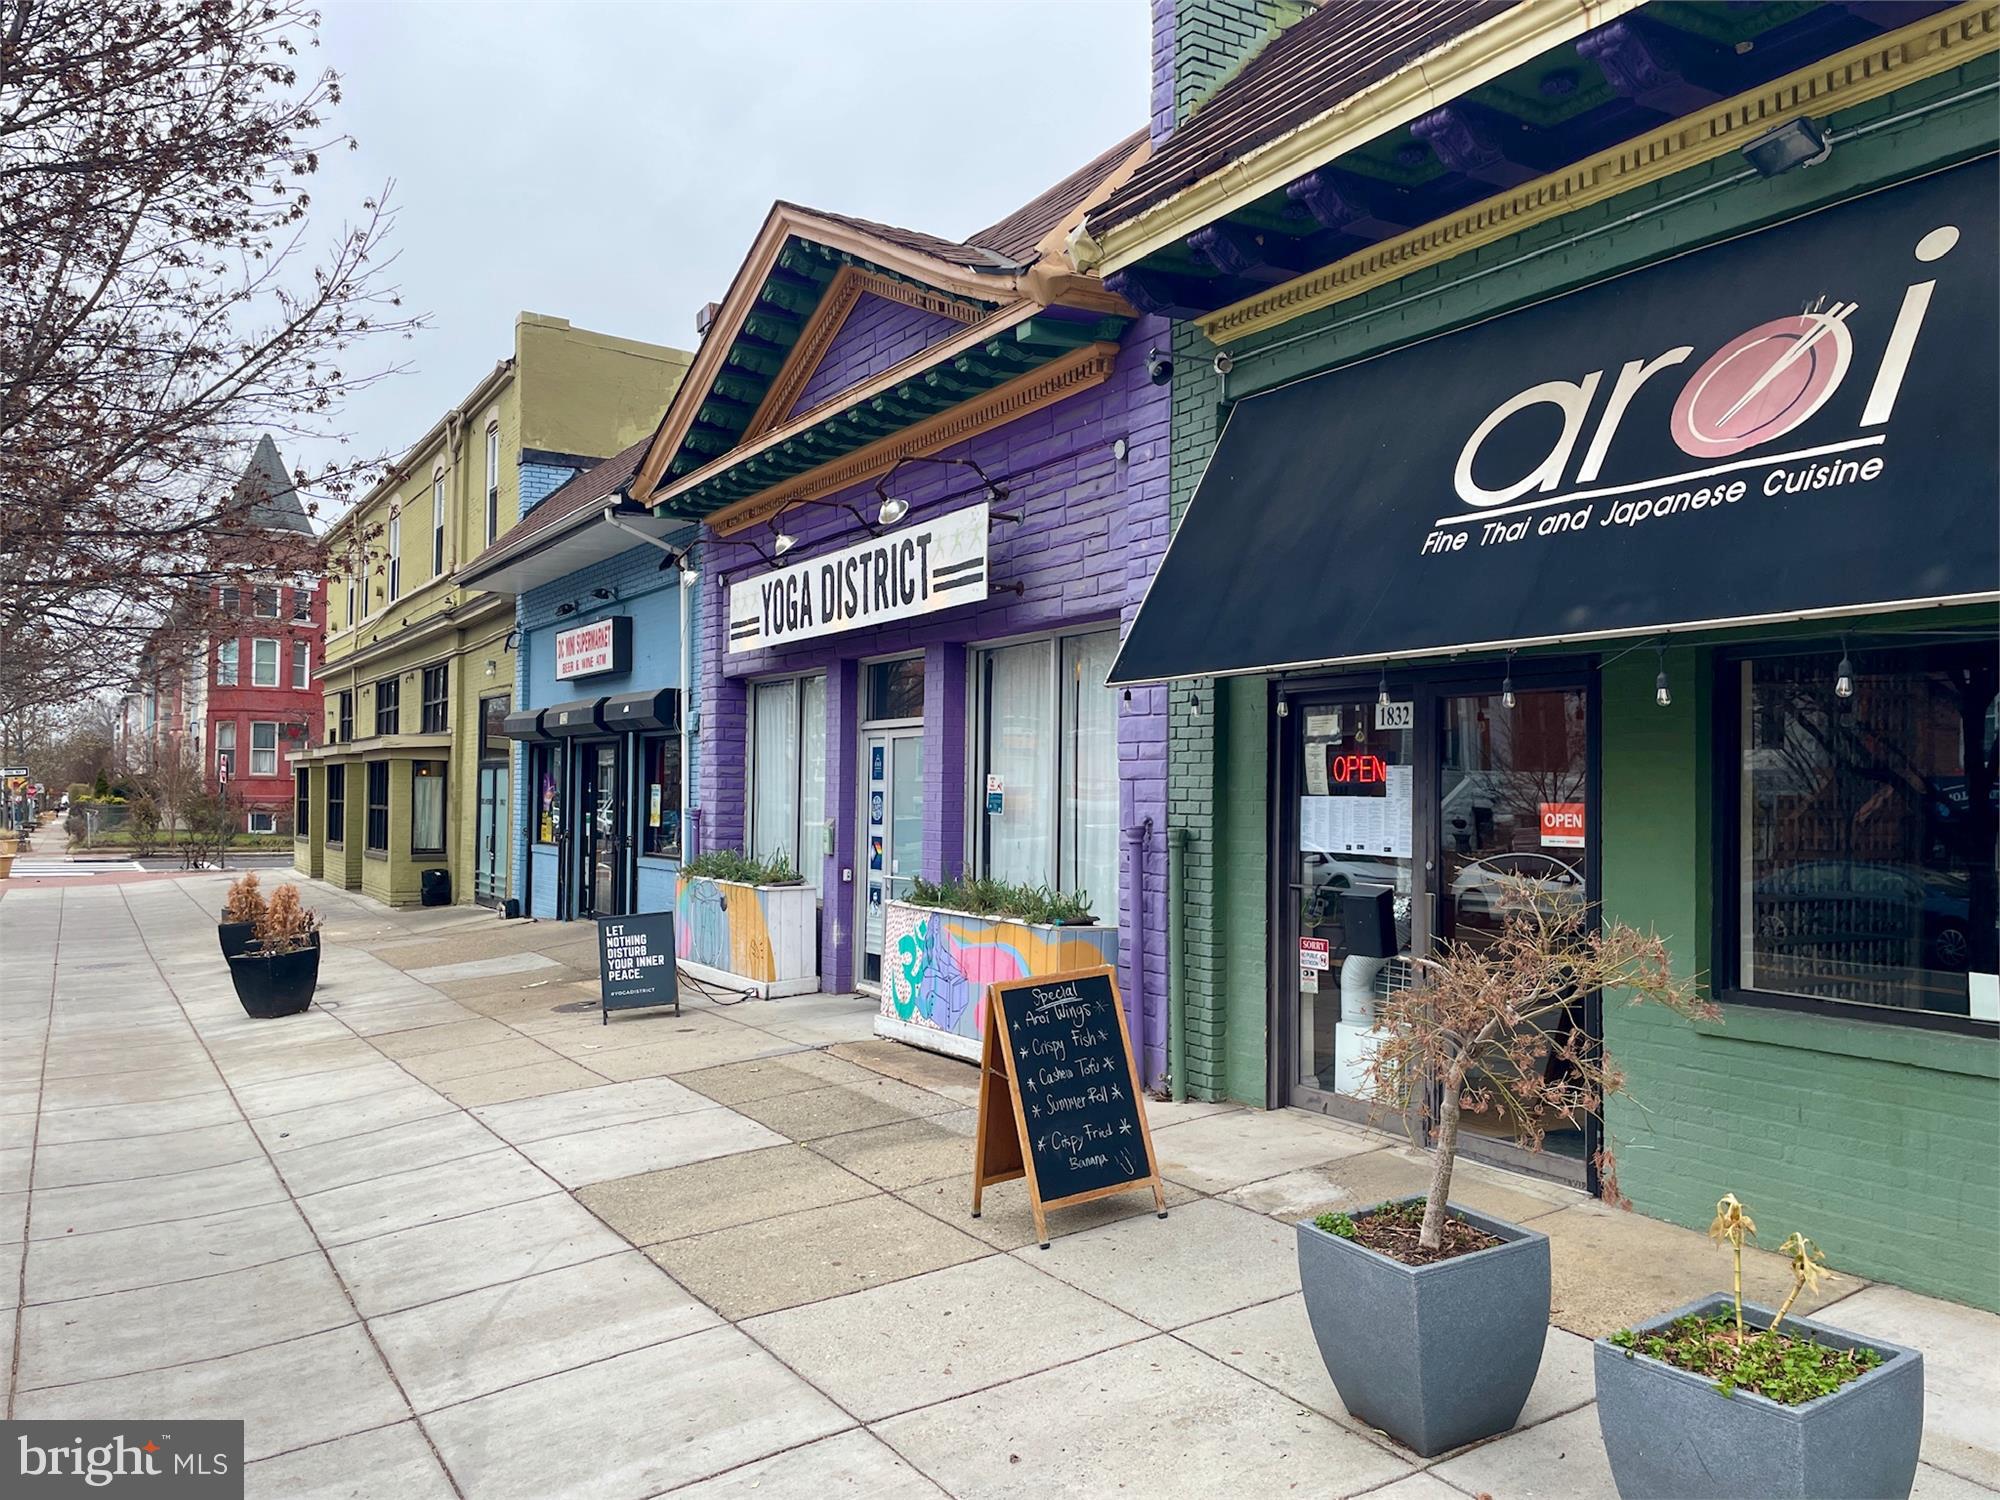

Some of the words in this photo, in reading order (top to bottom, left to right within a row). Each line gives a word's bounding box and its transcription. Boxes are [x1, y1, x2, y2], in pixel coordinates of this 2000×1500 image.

[1453, 225, 1960, 507] aroi
[1421, 530, 1468, 556] Fine
[1480, 516, 1530, 546] Thai
[1537, 504, 1587, 536] and
[1600, 479, 1747, 528] Japanese
[1762, 455, 1885, 495] Cuisine
[762, 570, 813, 637] YOGA
[821, 532, 932, 624] DISTRICT
[558, 639, 565, 659] DC
[576, 624, 611, 654] SUPERMARKET
[562, 661, 574, 674] BEER
[581, 656, 594, 669] WINE
[596, 653, 607, 666] ATM
[1380, 705, 1409, 727] 1832
[1333, 755, 1386, 783] OPEN
[1543, 813, 1583, 828] OPEN
[605, 925, 624, 937] LET
[606, 934, 647, 948] NOTHING
[607, 945, 647, 959] DISTURB
[1302, 939, 1326, 951] SORRY
[608, 957, 634, 970] YOUR
[636, 954, 665, 968] INNER
[608, 968, 644, 981] PEACE.
[610, 987, 655, 996] #YOGADISTRICT
[1032, 982, 1079, 1007] Special
[1025, 1010, 1050, 1028] Aroi
[1053, 1003, 1092, 1029] Wings
[1032, 1038, 1065, 1061] Crispy
[1071, 1029, 1097, 1048] Fish
[1038, 1067, 1074, 1087] Cashew
[1074, 1057, 1101, 1077] Tofu
[1046, 1094, 1086, 1116] Summer
[1088, 1086, 1109, 1105] Roll
[1051, 1131, 1084, 1154] Crispy
[1083, 1122, 1113, 1142] Fried
[1069, 1154, 1110, 1171] Banana
